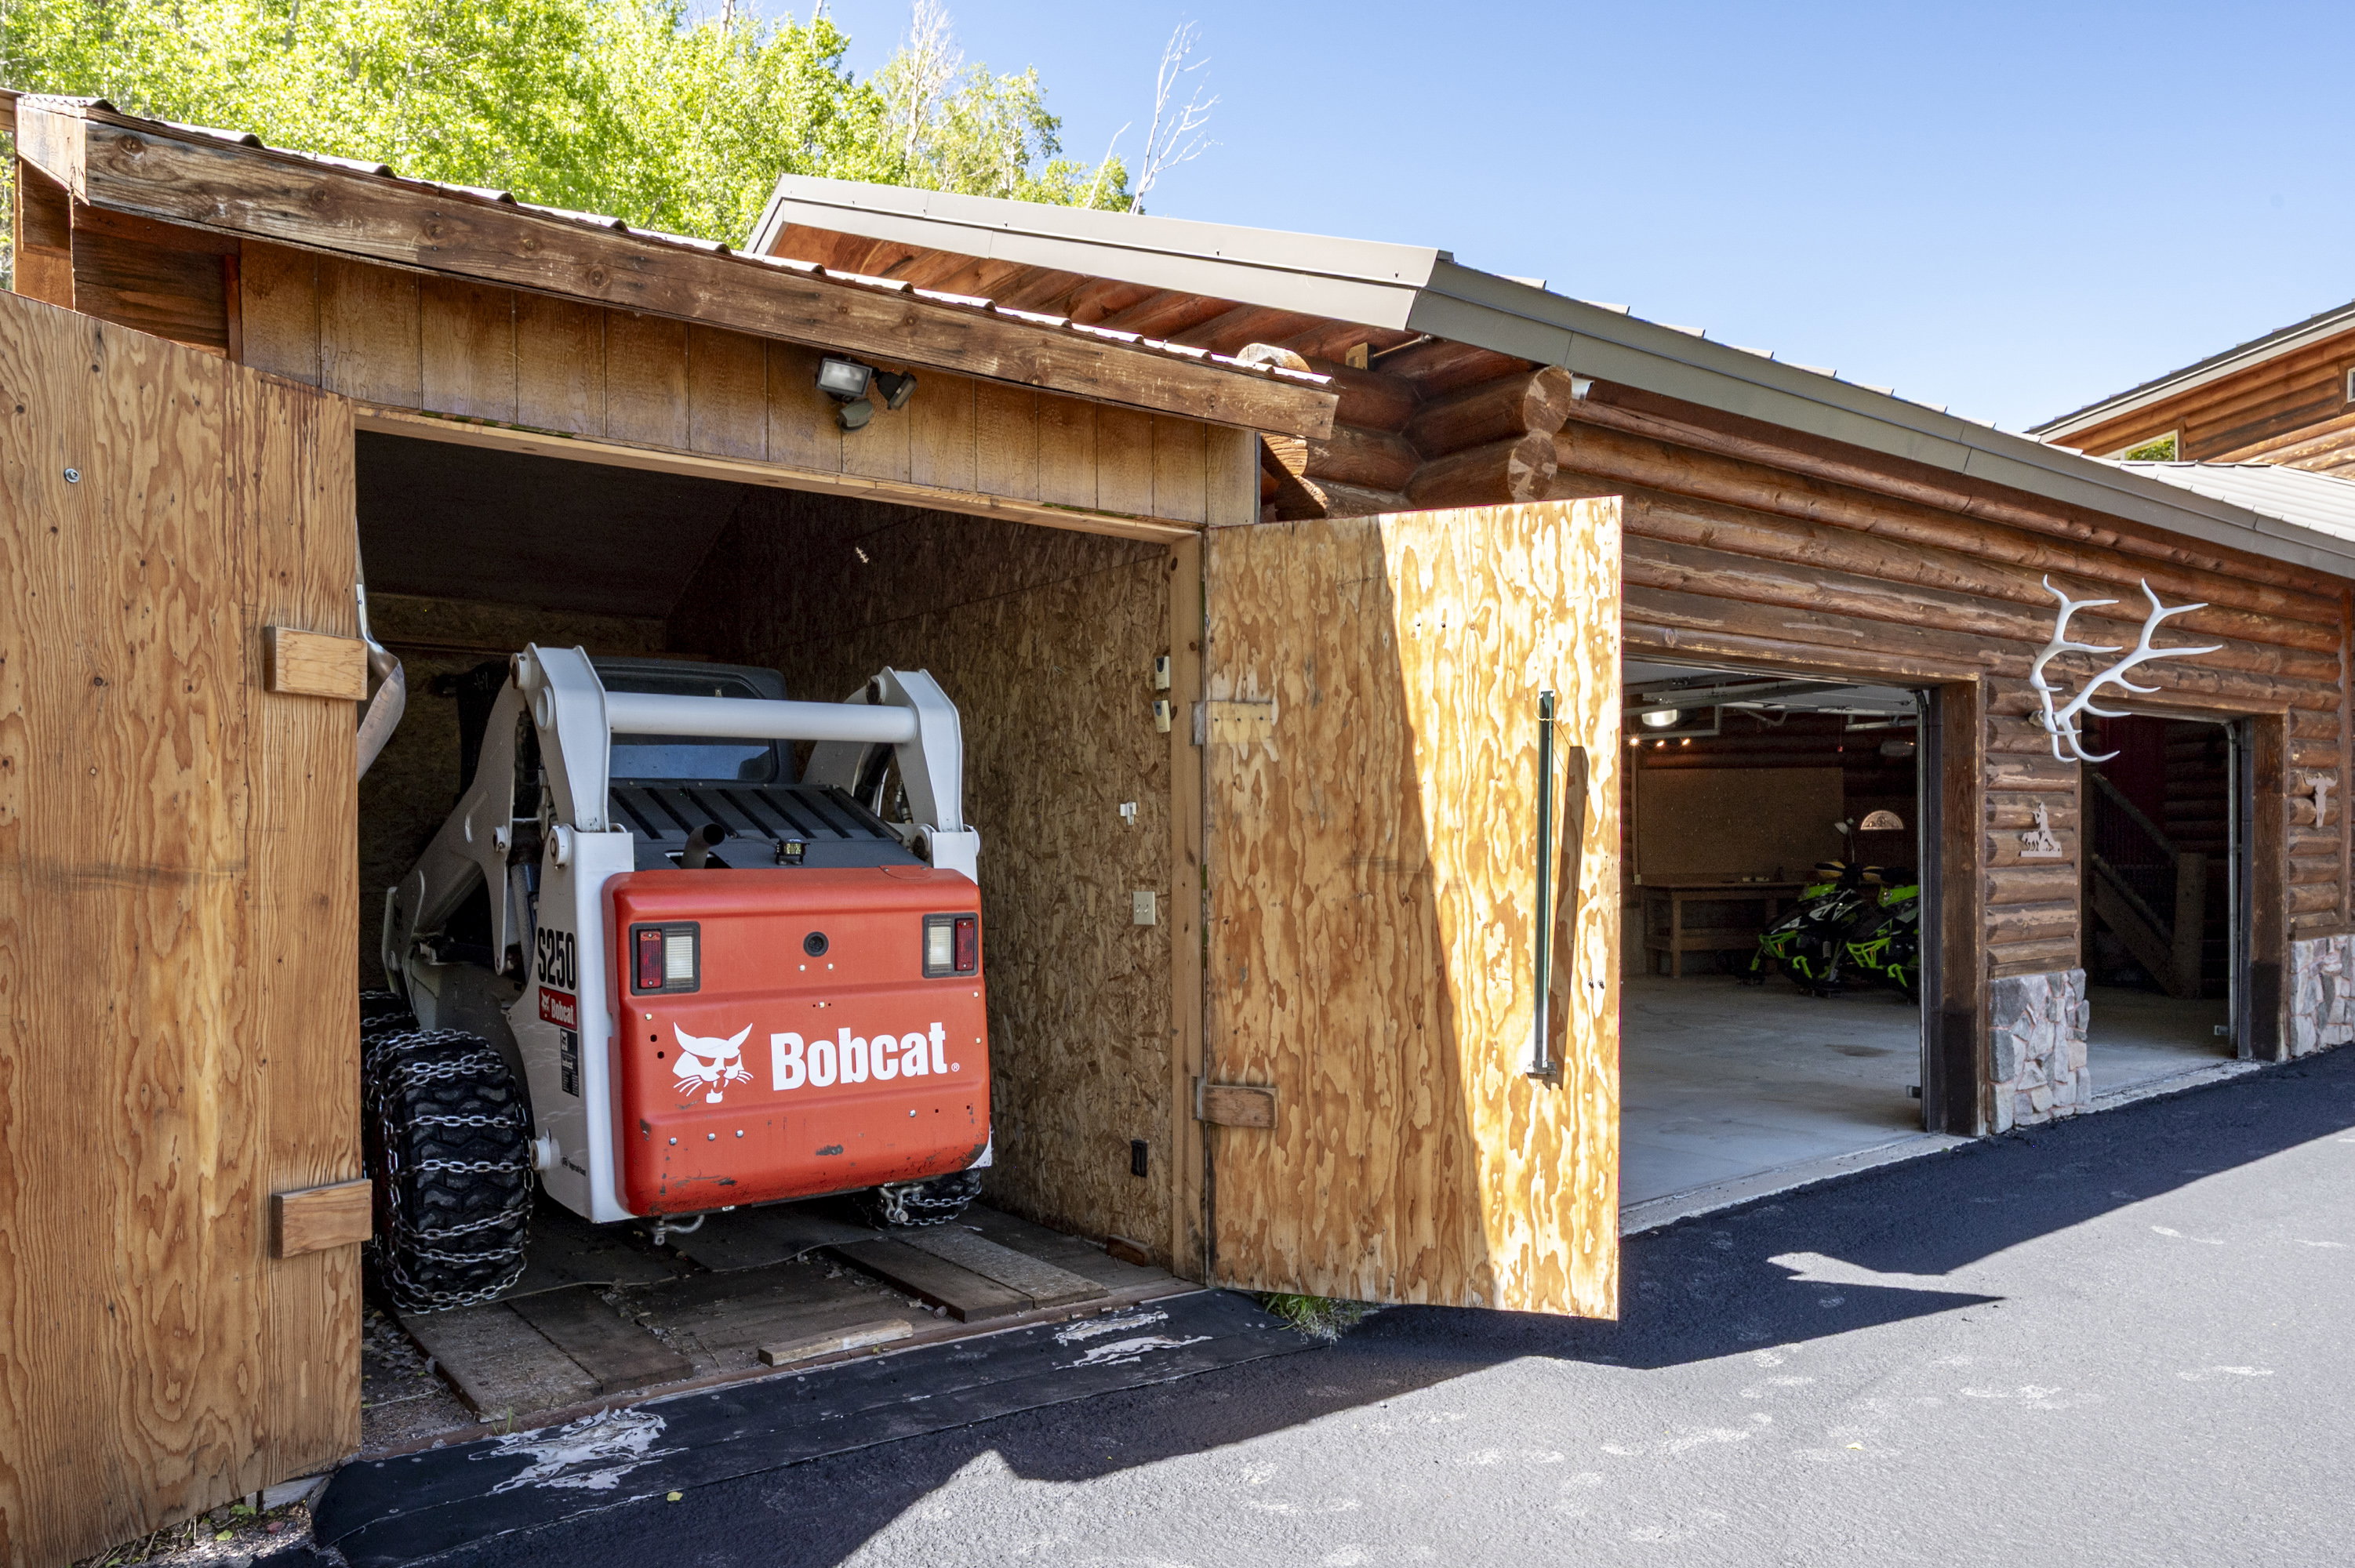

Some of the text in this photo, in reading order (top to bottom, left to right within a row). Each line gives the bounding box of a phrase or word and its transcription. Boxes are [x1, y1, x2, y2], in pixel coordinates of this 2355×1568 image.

[537, 927, 576, 990] S250
[551, 998, 574, 1025] Bobcat
[770, 1022, 947, 1091] Bobcat
